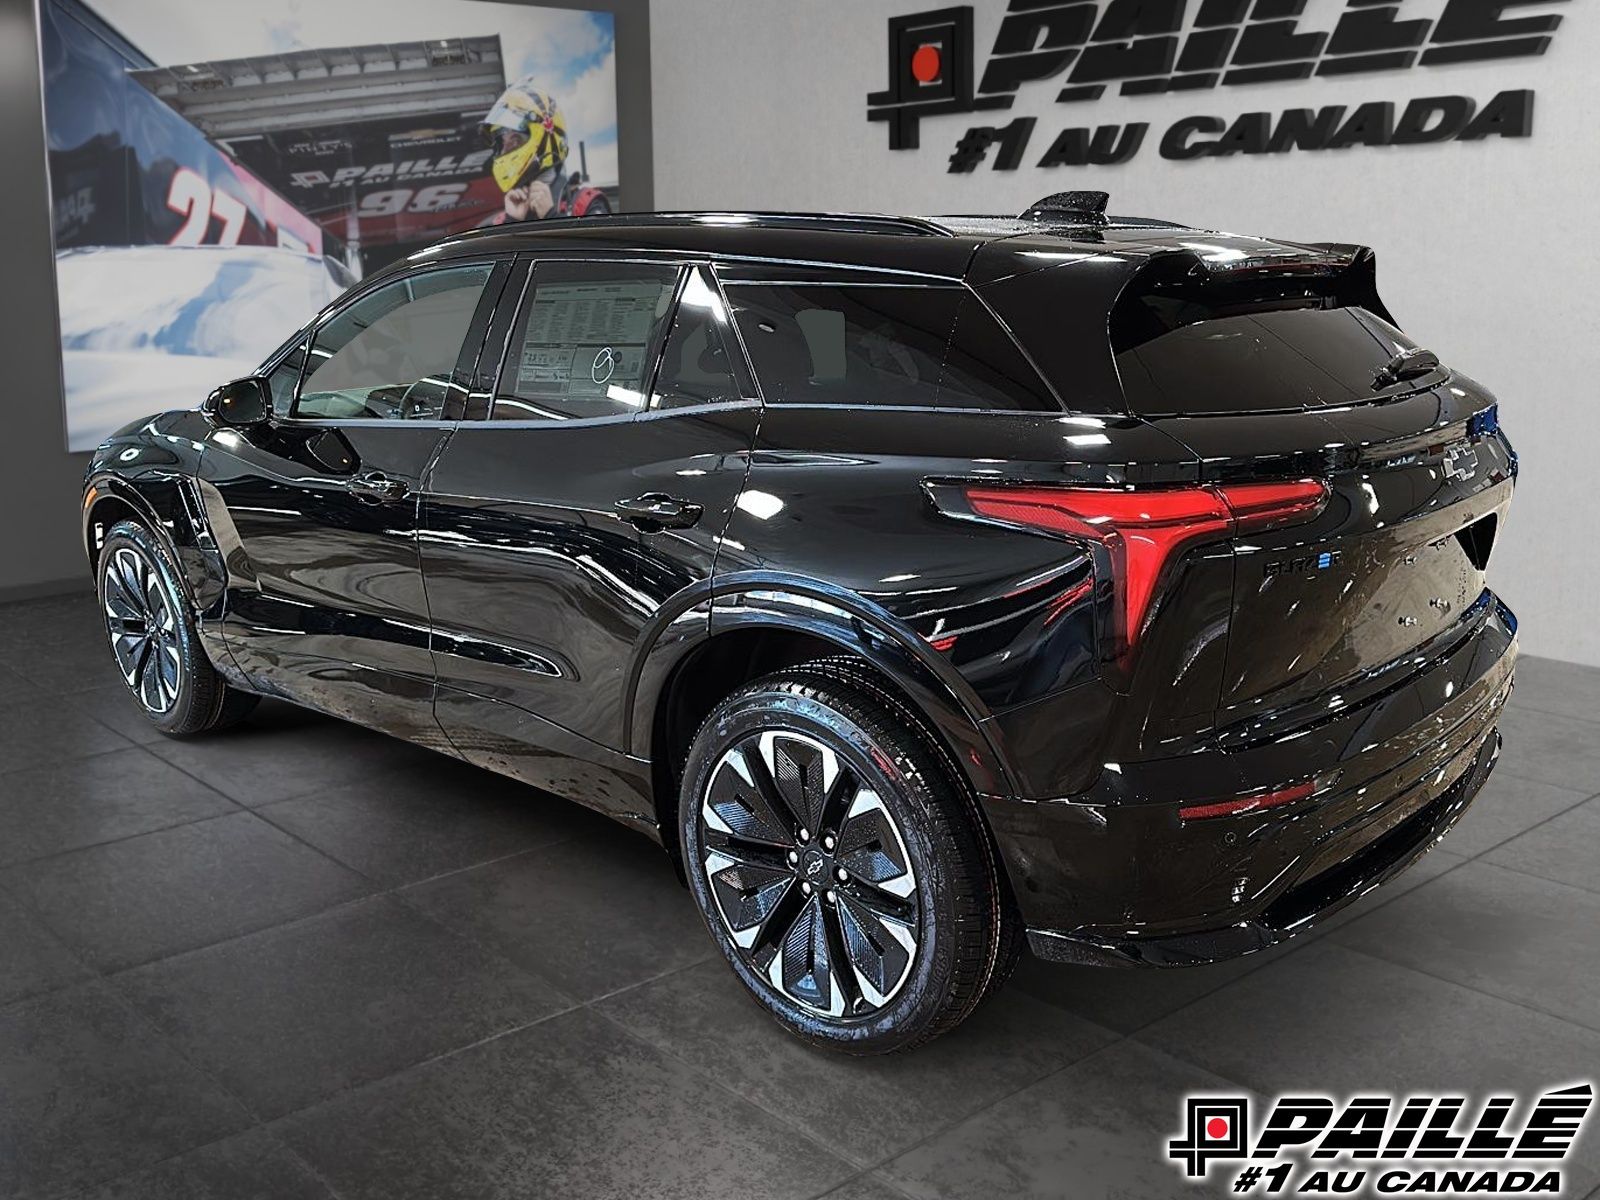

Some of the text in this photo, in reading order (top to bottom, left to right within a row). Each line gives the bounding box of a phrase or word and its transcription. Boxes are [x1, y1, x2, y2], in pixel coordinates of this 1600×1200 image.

[947, 89, 1535, 173] #1 AU CANADA
[166, 166, 247, 246] 27
[357, 183, 468, 218] 96
